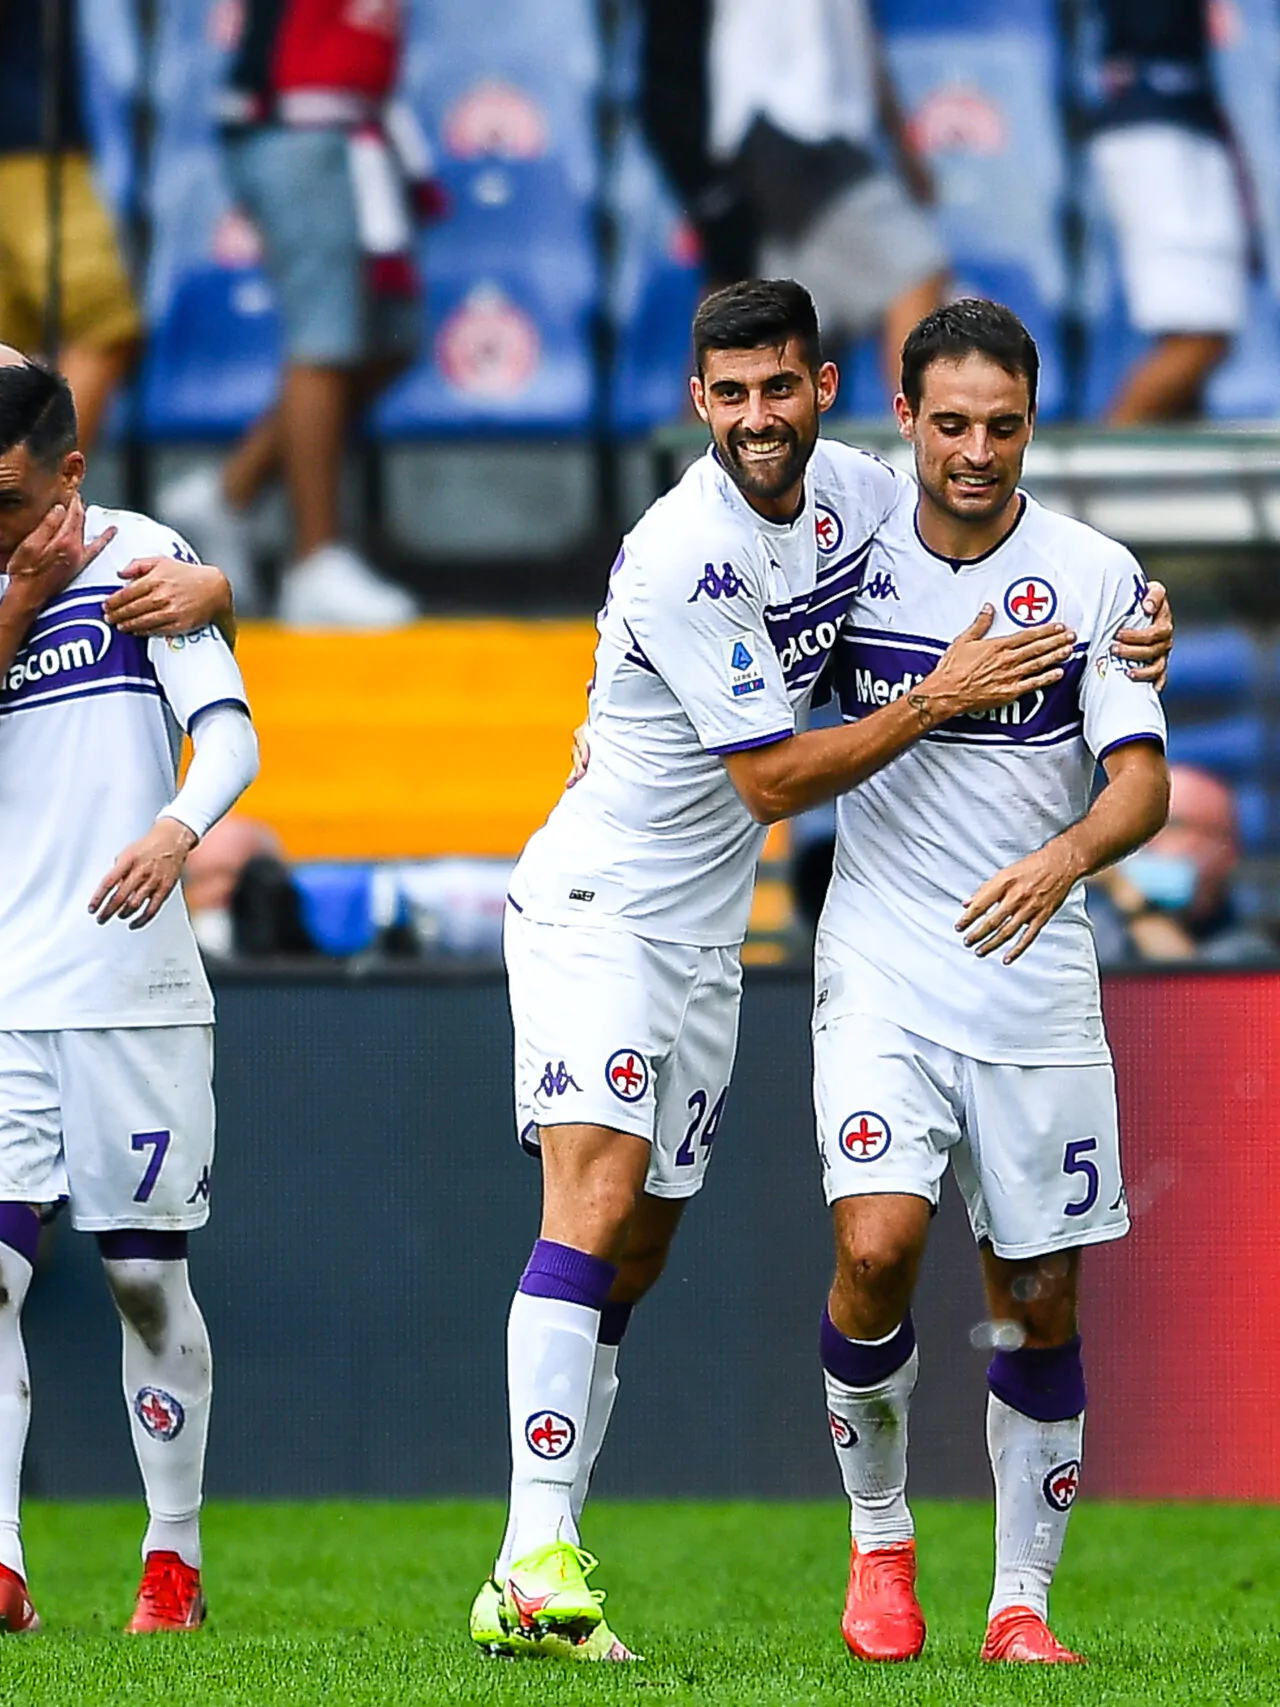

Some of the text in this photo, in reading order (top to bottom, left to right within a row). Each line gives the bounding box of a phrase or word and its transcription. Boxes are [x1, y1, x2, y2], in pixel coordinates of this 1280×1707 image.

[1, 639, 95, 690] acom
[674, 1085, 729, 1167] 24
[130, 1129, 172, 1204] 7
[1062, 1136, 1100, 1217] 5
